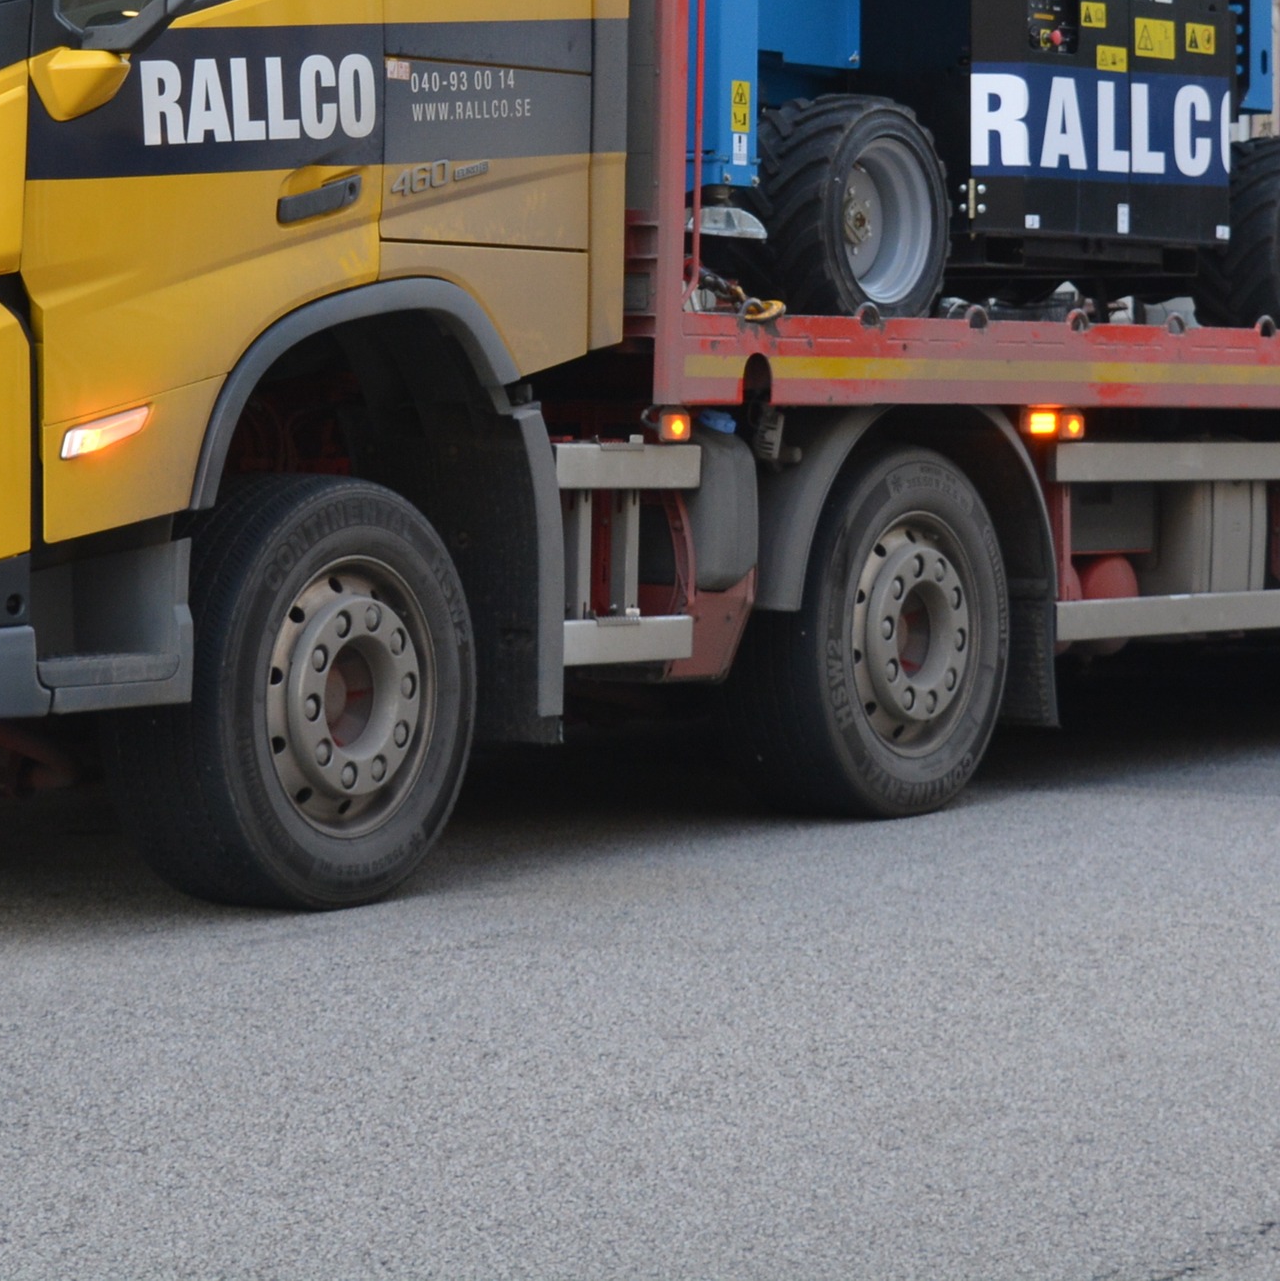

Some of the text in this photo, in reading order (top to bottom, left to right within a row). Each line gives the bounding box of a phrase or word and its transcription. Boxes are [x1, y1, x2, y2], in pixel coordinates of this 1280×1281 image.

[140, 53, 376, 146] RALLCO
[411, 69, 515, 93] 040-93 00 14
[412, 99, 531, 122] WWW.RALLCO.SE
[971, 73, 1230, 177] RALLC
[391, 159, 450, 197] 460
